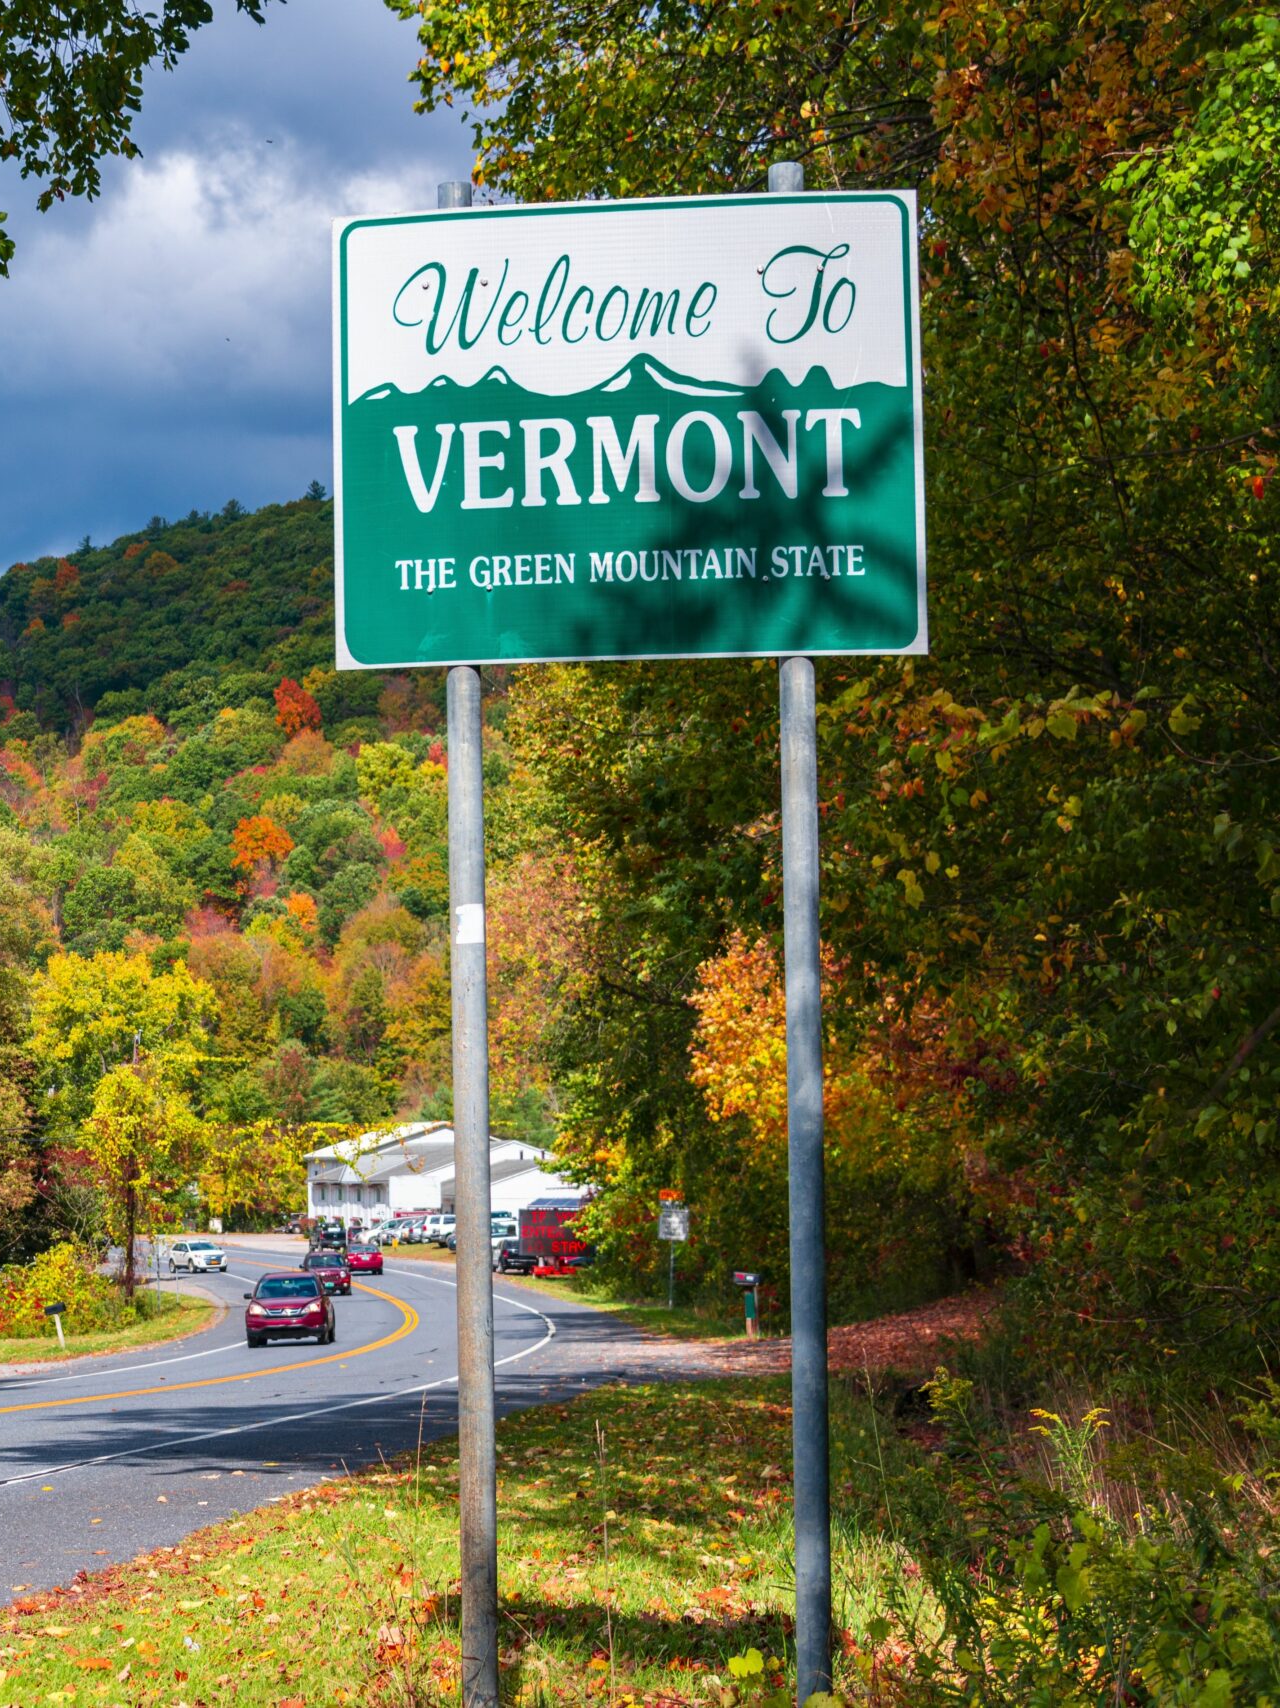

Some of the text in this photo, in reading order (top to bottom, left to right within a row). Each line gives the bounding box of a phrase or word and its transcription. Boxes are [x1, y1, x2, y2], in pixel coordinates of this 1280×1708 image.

[392, 243, 856, 356] Welcome To
[392, 407, 862, 514] VERMONT
[394, 544, 866, 591] THE GREEN MOUNTAIN STATE
[551, 1240, 587, 1253] STAY
